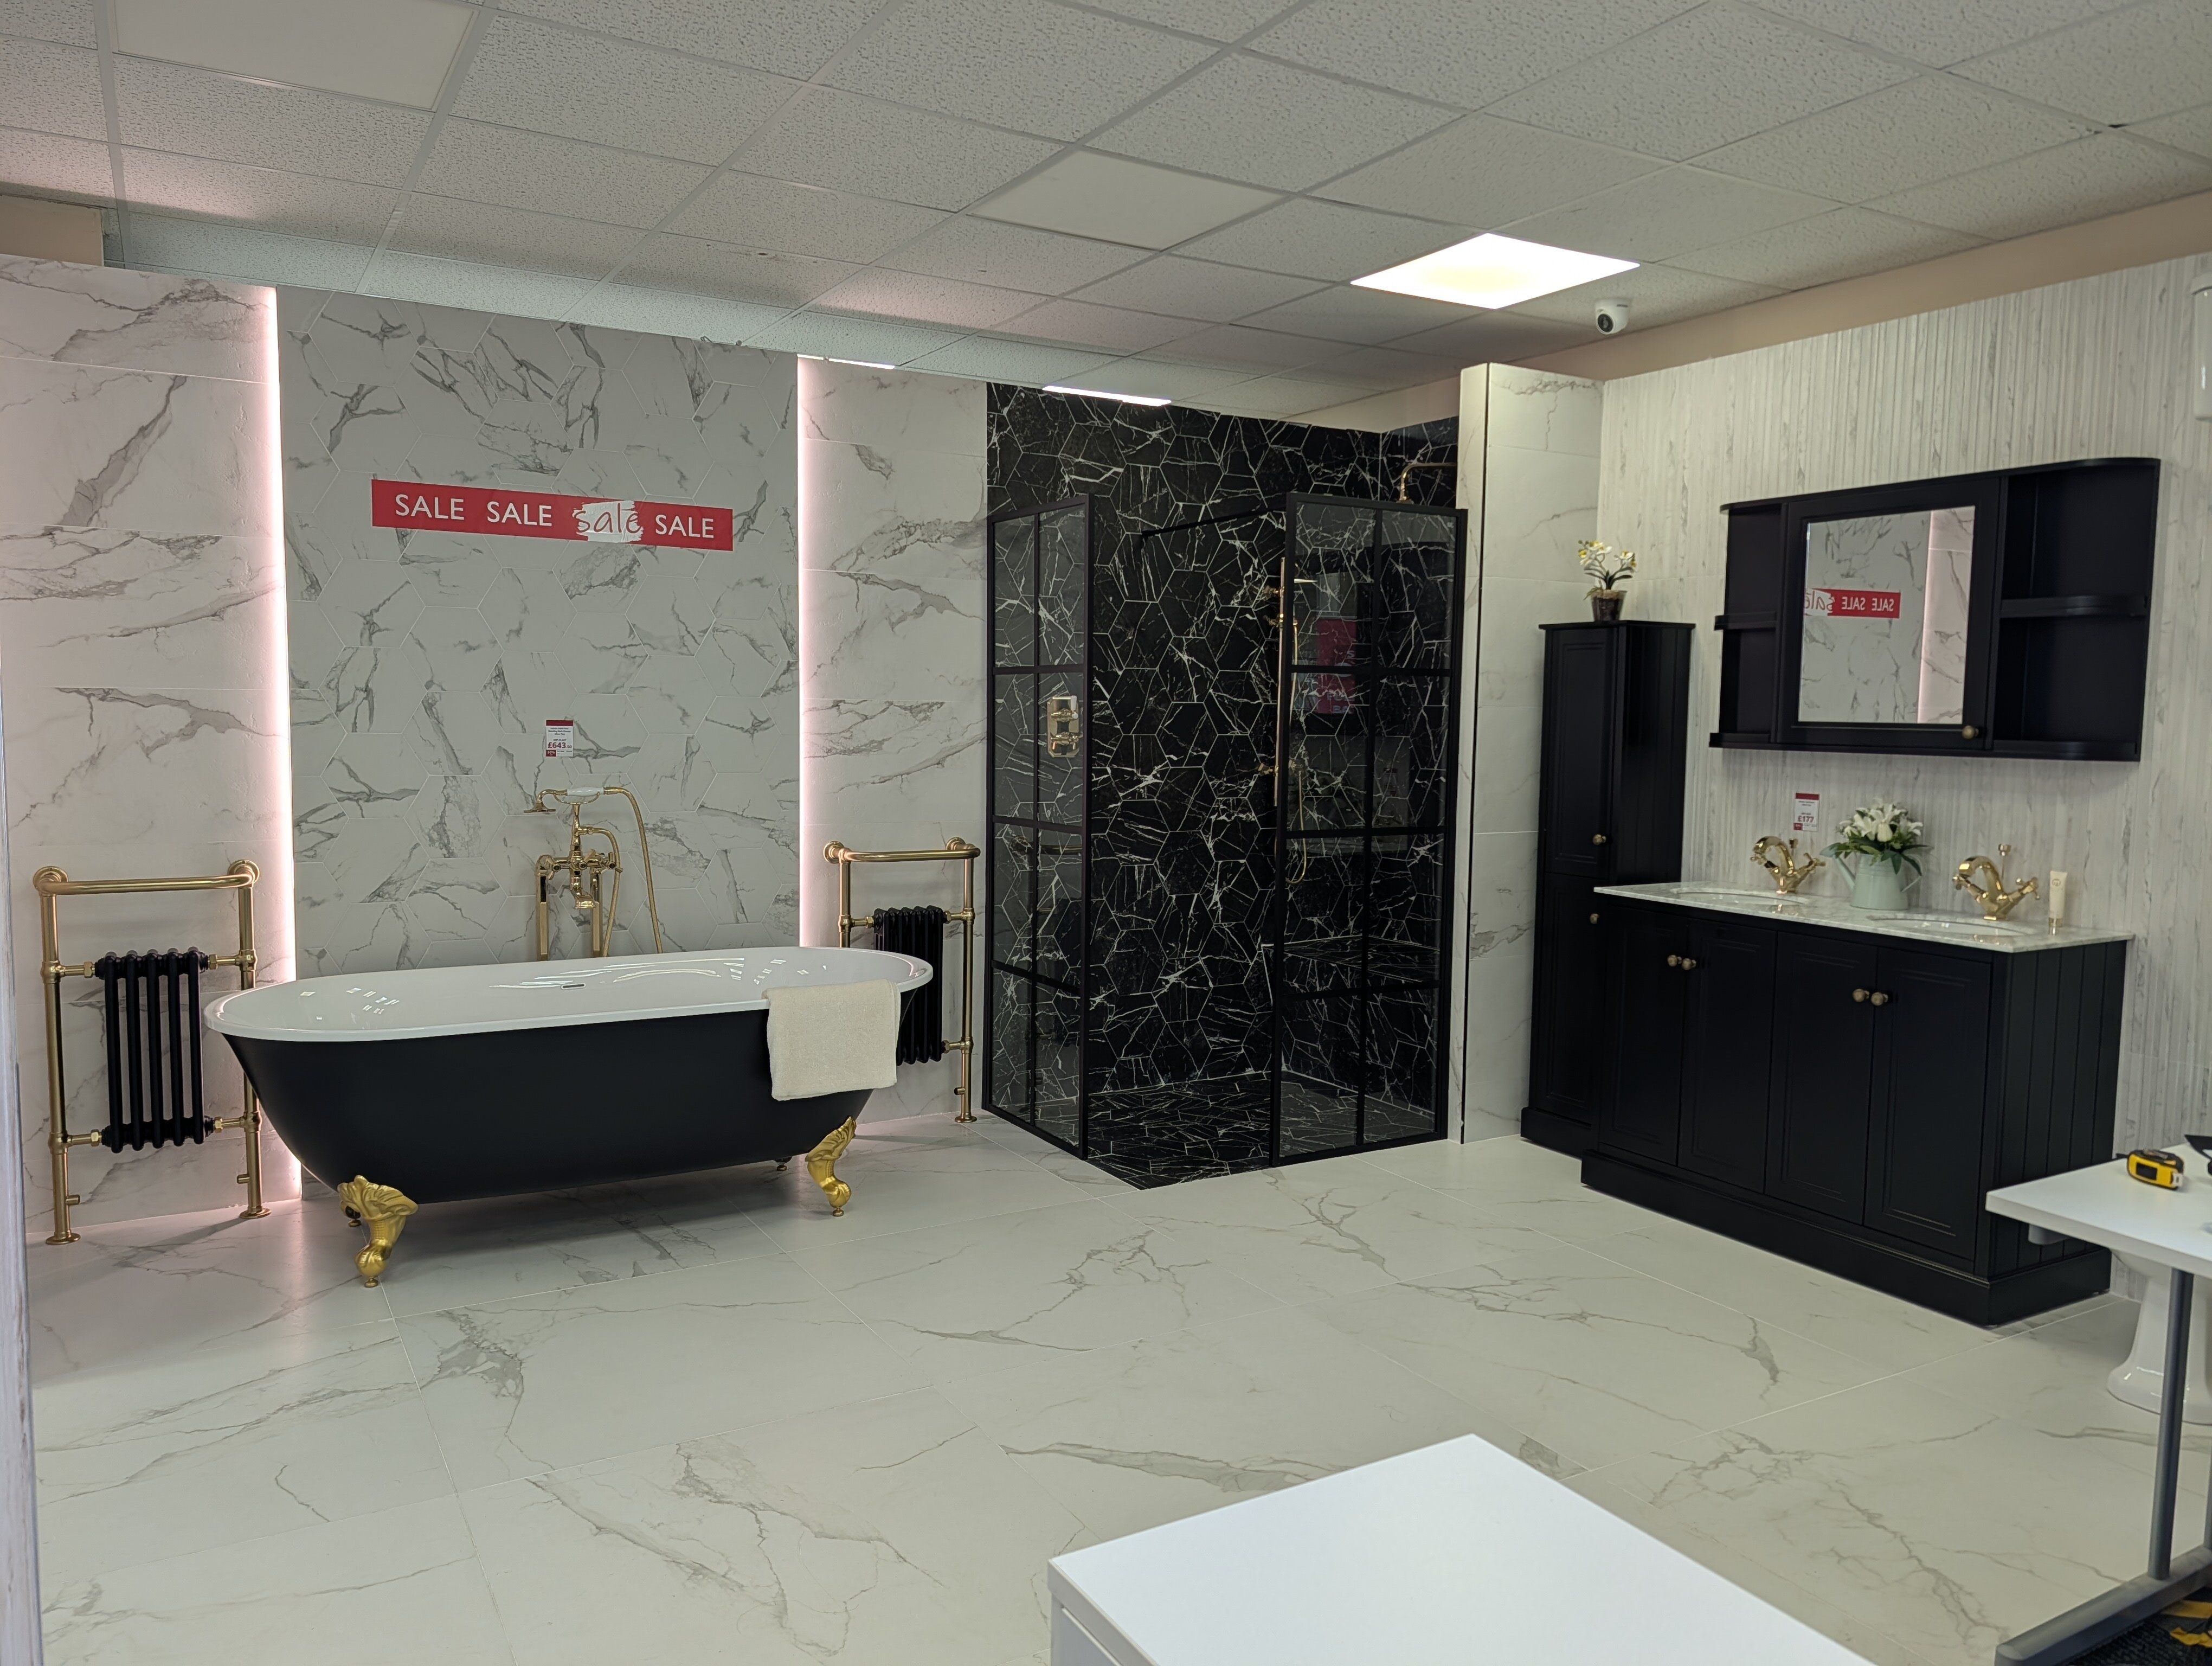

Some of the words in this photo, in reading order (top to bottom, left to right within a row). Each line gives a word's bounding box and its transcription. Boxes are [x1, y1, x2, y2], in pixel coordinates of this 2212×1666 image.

[395, 494, 465, 521] SALE
[487, 501, 552, 527] SALE
[573, 502, 642, 534] sale
[655, 514, 715, 539] SALE
